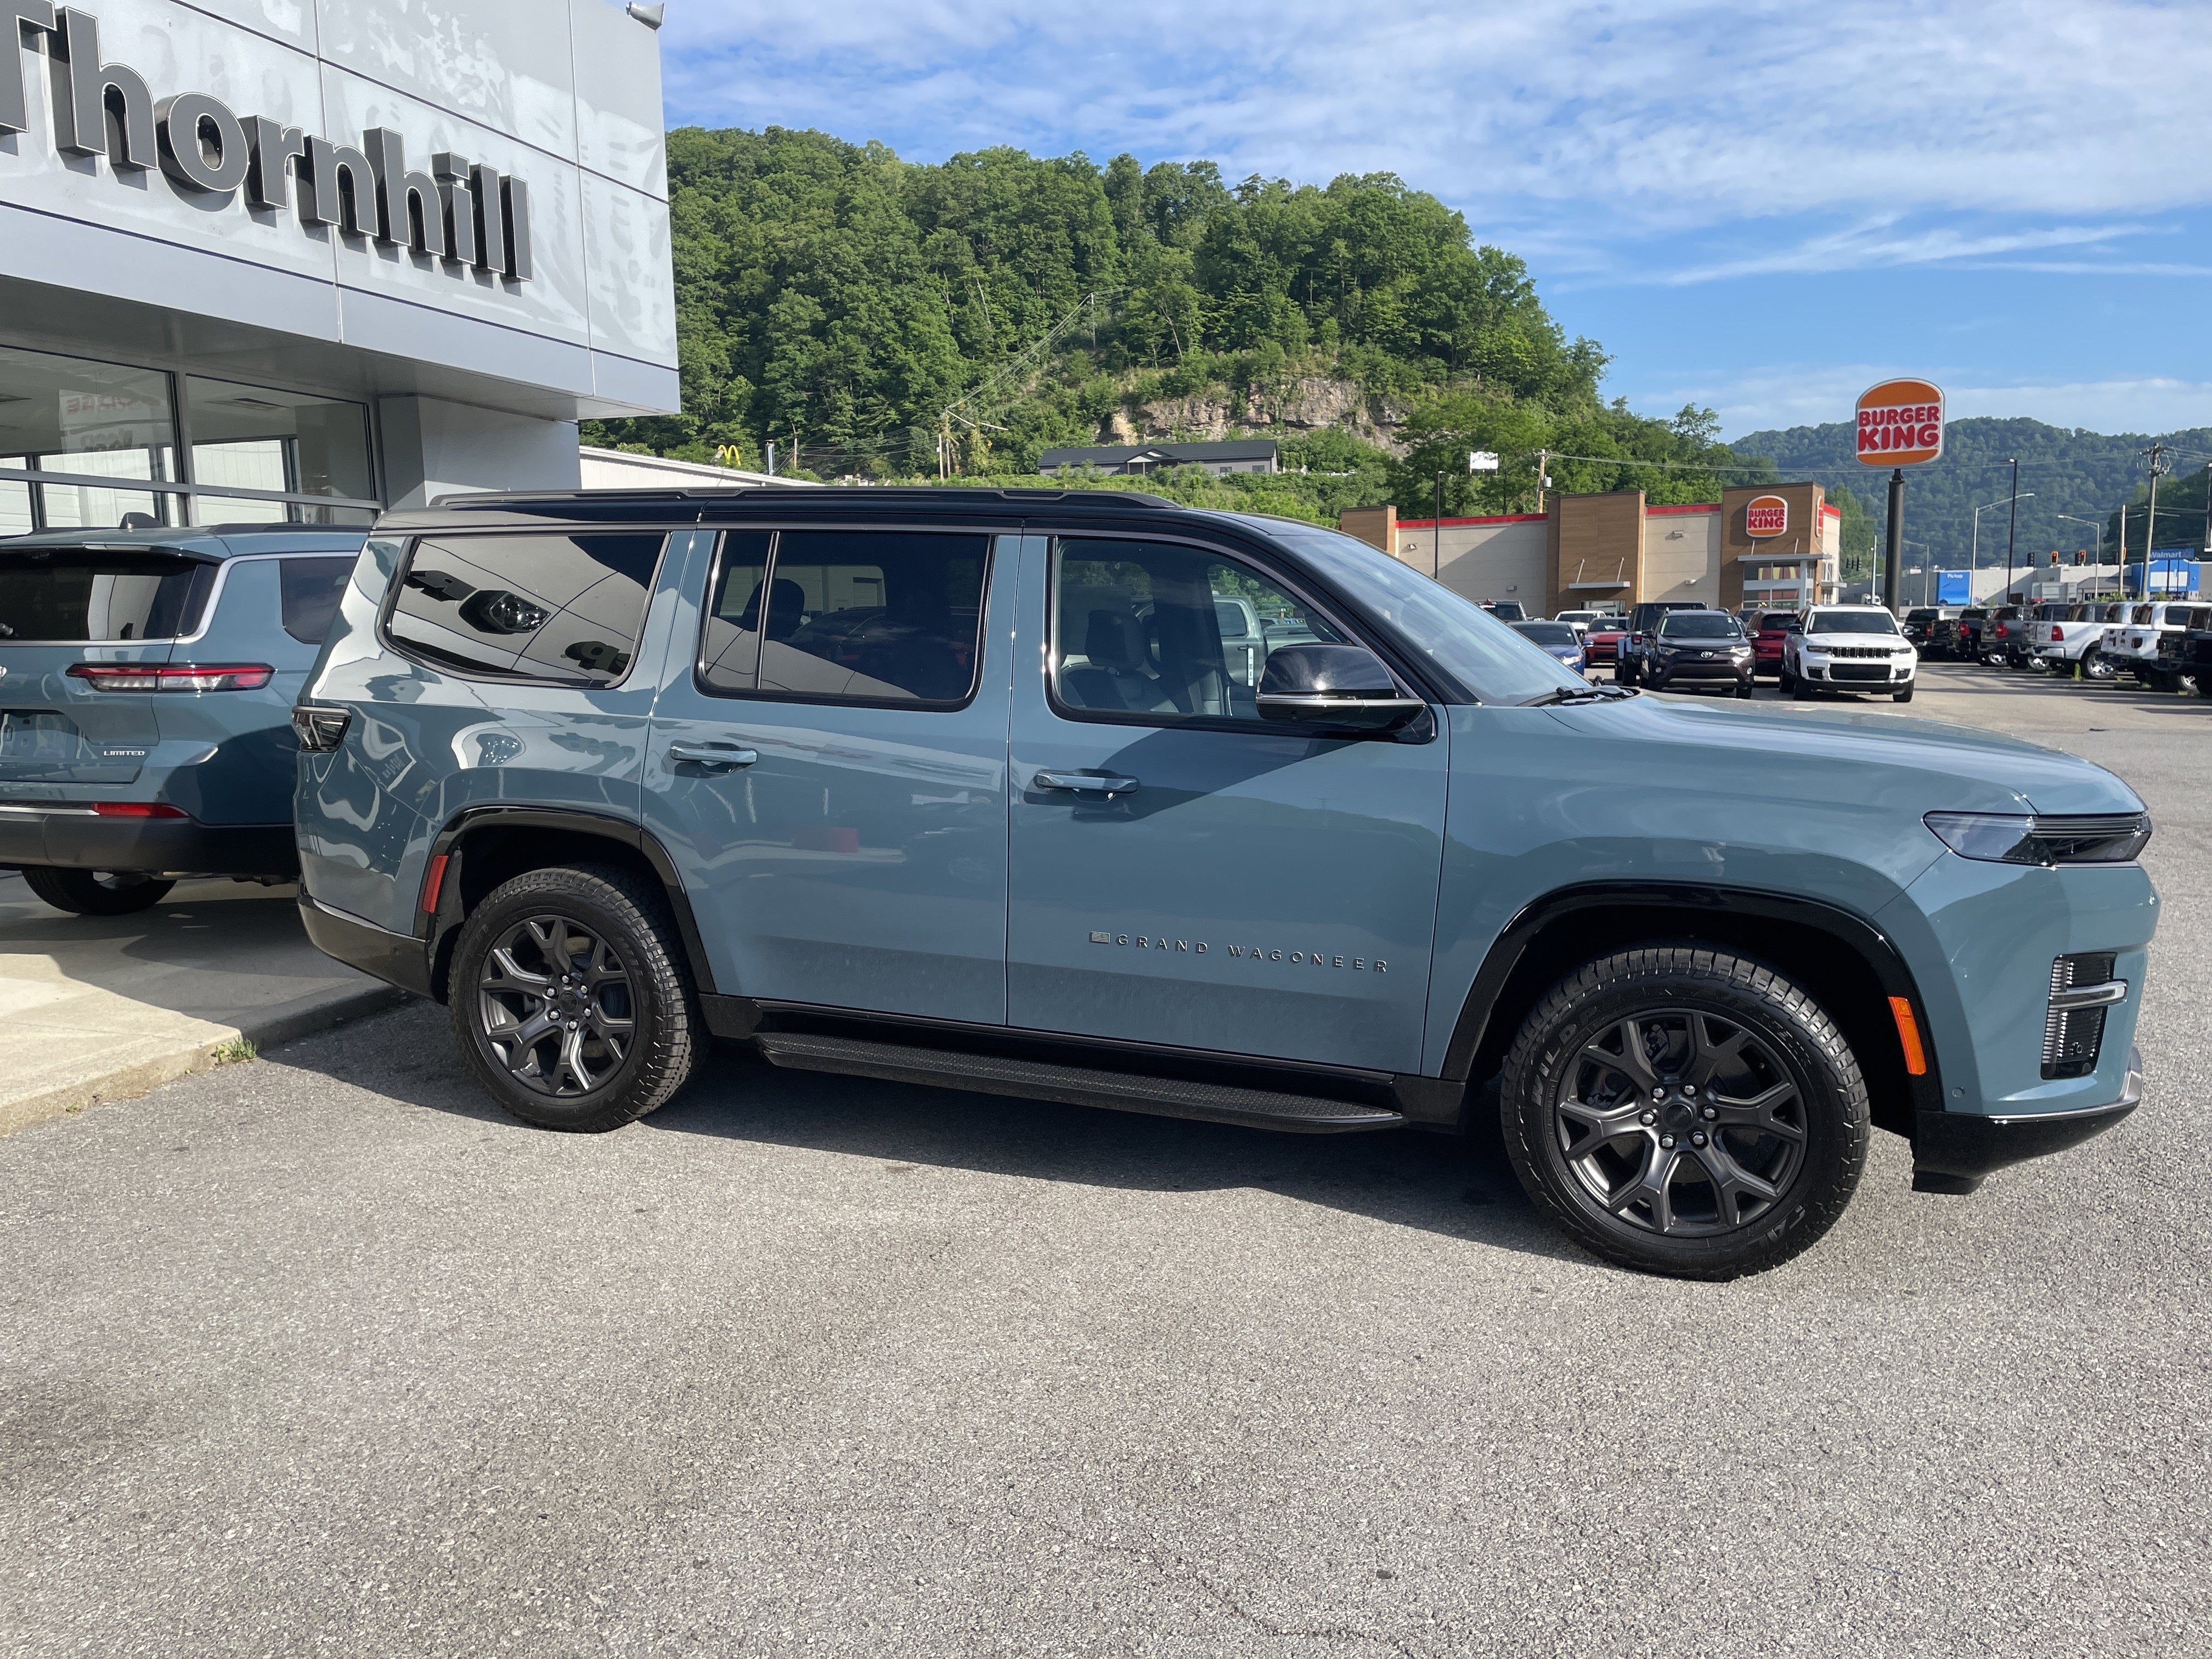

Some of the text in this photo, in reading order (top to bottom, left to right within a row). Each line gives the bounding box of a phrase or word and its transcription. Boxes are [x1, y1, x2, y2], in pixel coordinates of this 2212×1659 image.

[0, 0, 533, 282] Thornhill
[1858, 405, 1940, 427] BURGER
[1858, 424, 1939, 452] KING
[1748, 509, 1785, 517] BURGER
[1748, 517, 1785, 528] KING
[1117, 933, 1387, 973] GRAND WAGONEER
